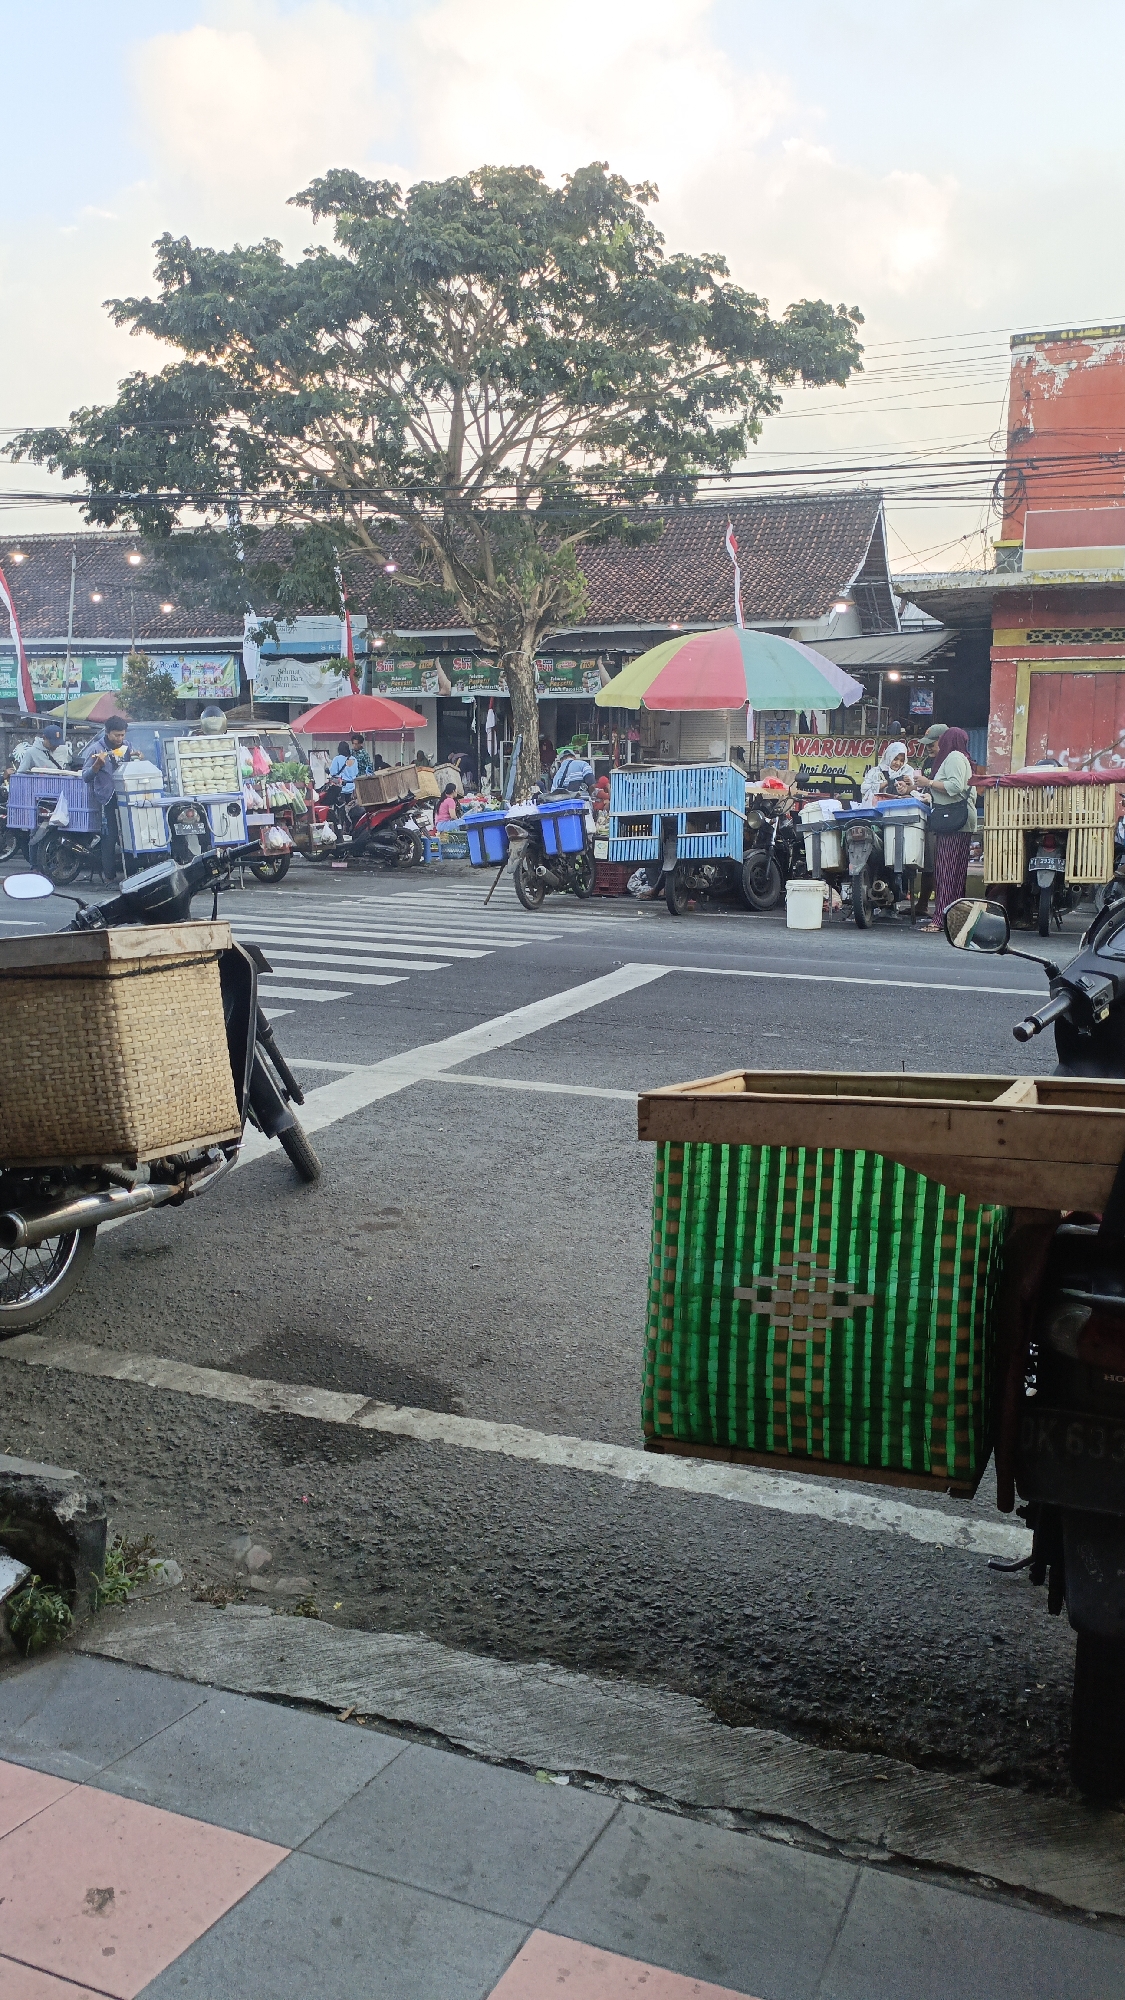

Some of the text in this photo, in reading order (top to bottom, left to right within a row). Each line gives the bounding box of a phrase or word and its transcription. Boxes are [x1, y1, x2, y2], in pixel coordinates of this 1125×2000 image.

[320, 643, 360, 651] SROO
[376, 660, 394, 672] SUN
[453, 657, 472, 671] SUN
[793, 737, 926, 758] WARUNG NSI
